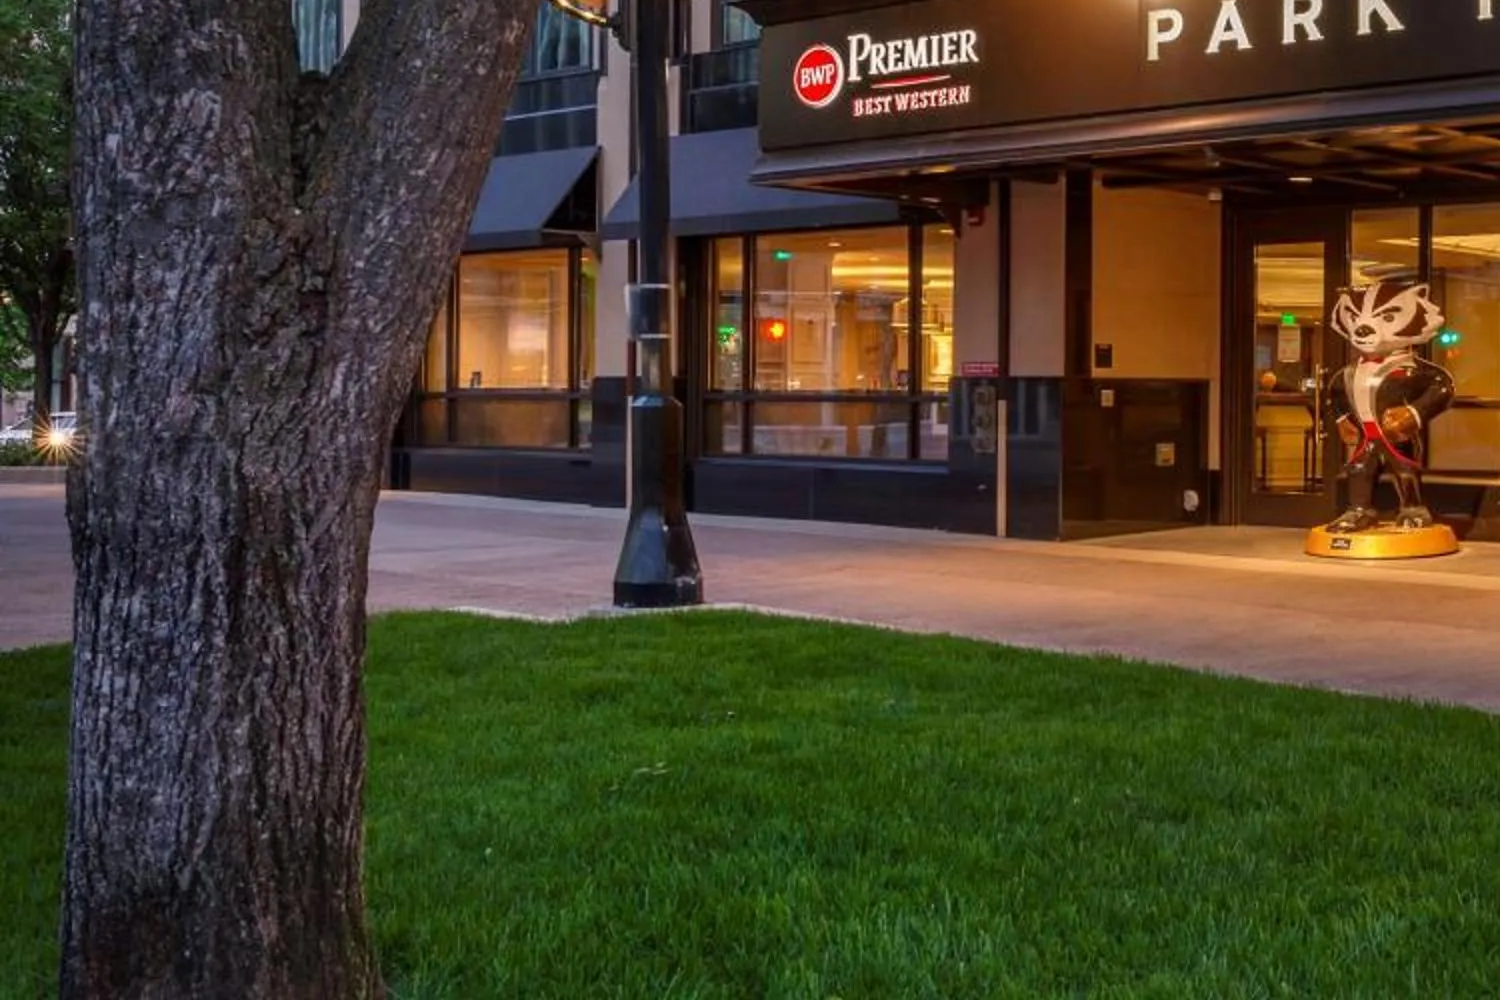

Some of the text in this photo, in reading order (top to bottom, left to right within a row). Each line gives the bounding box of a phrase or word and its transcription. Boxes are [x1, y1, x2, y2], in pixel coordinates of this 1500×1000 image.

[847, 29, 980, 82] PREMIER
[800, 63, 836, 89] BWP
[853, 86, 971, 117] BEST WESTERN
